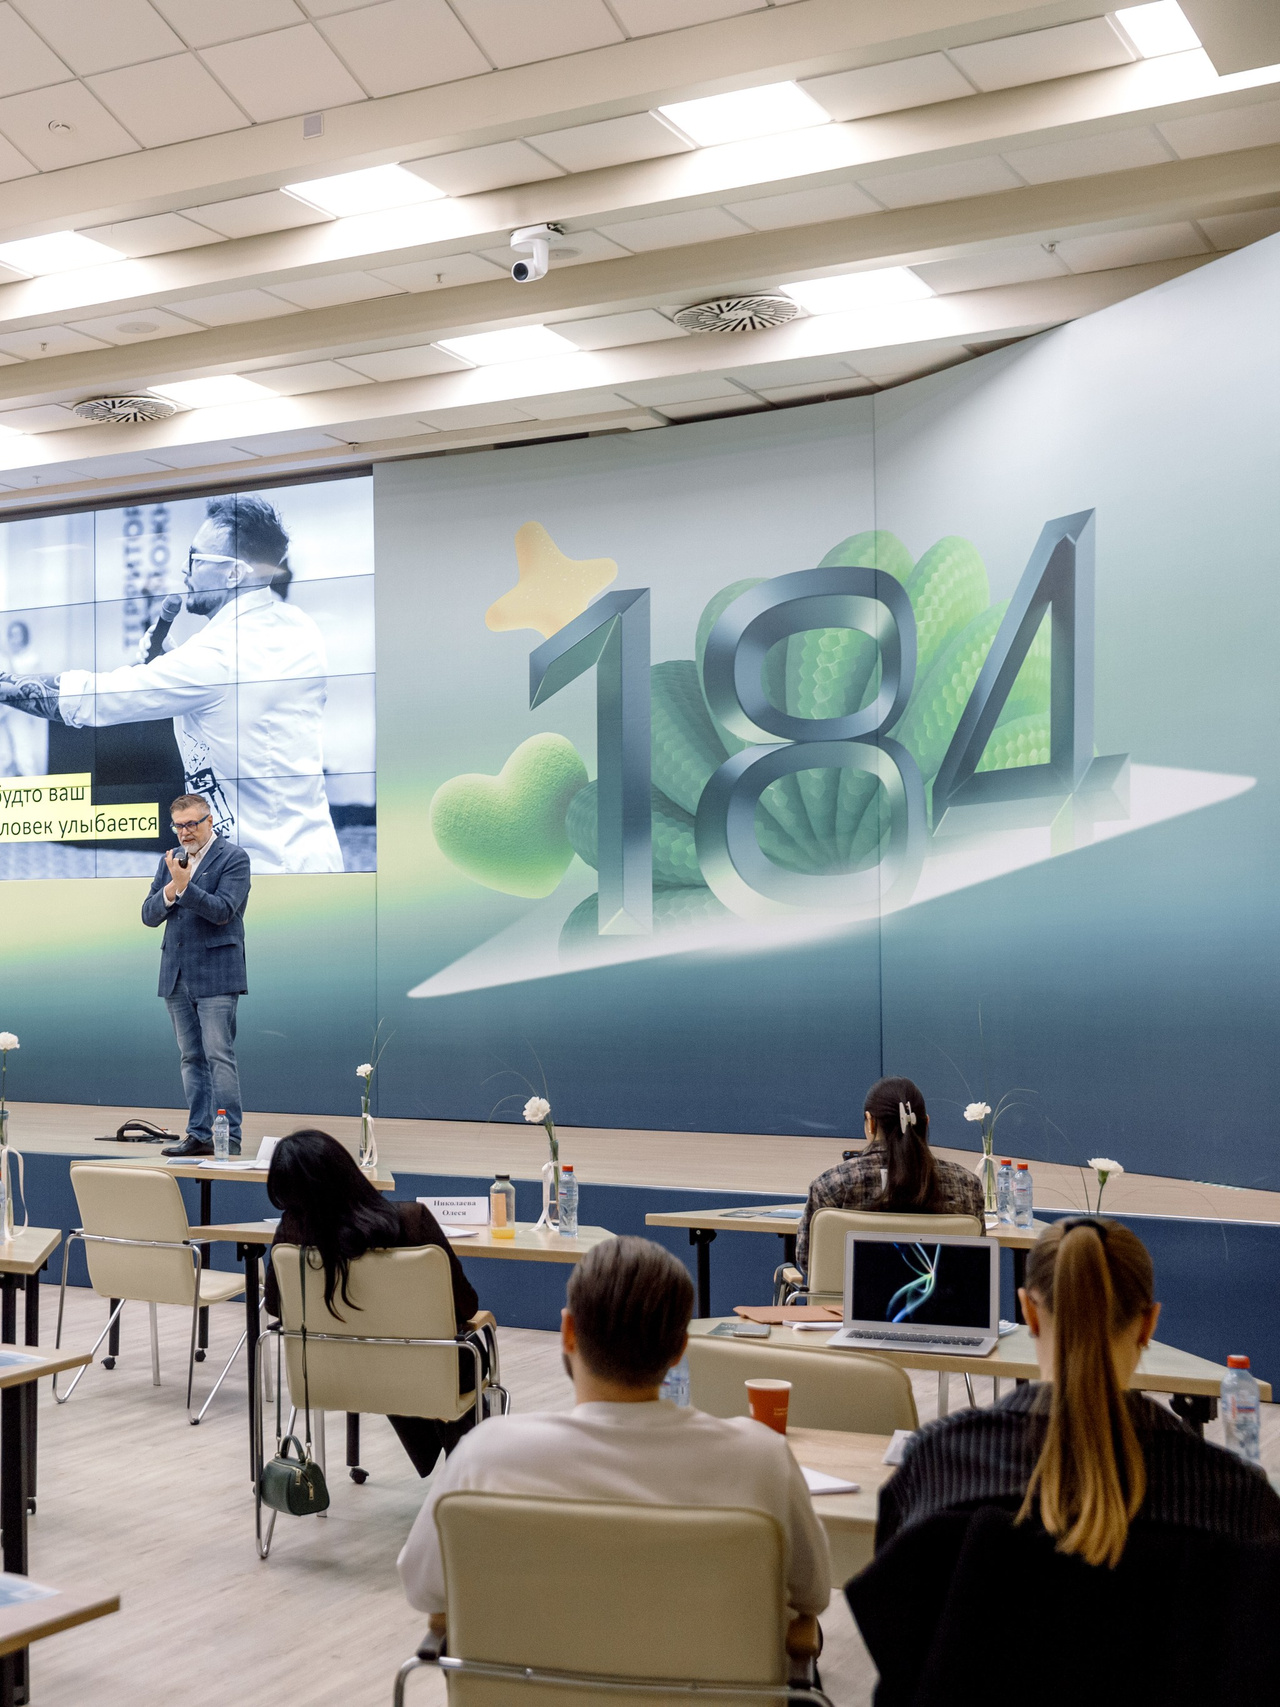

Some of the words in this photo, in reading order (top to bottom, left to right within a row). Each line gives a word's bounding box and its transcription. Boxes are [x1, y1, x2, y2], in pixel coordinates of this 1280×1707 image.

[528, 507, 1131, 936] 184
[49, 787, 85, 801] ваш
[58, 812, 158, 839] улыбается
